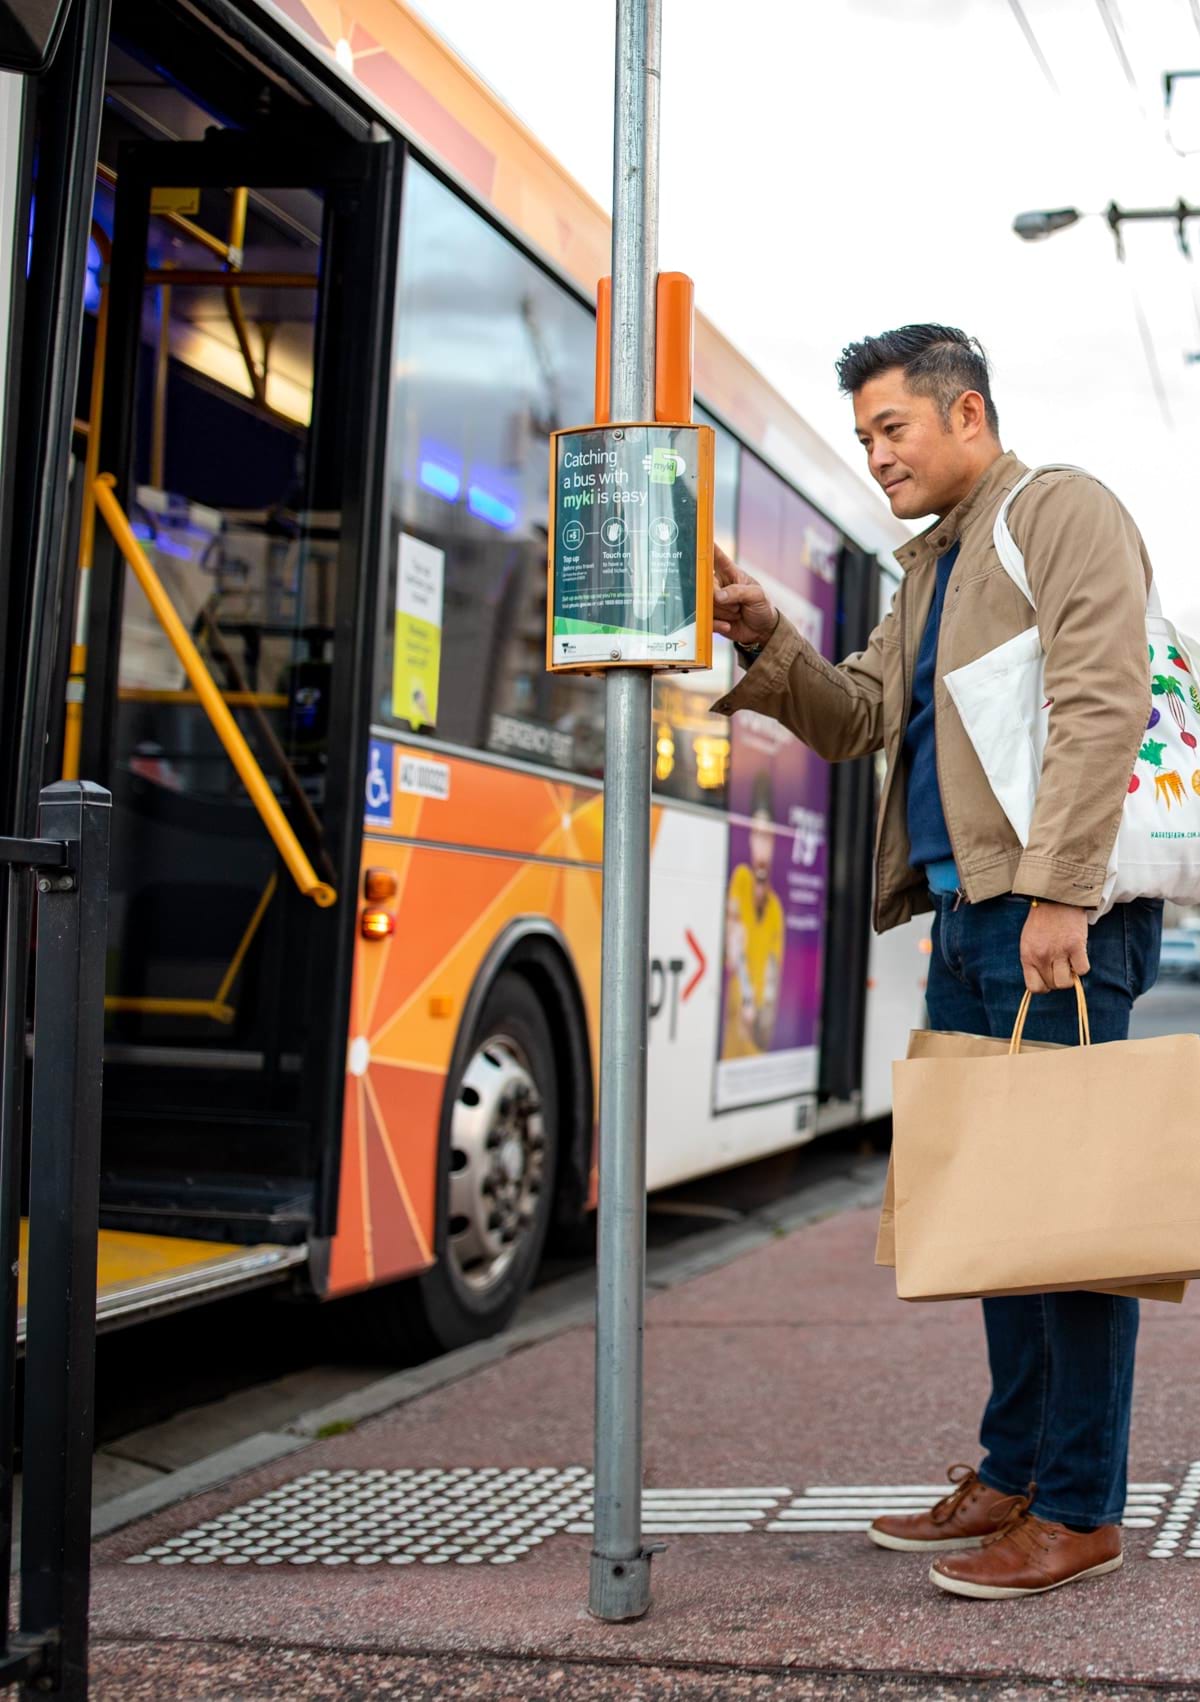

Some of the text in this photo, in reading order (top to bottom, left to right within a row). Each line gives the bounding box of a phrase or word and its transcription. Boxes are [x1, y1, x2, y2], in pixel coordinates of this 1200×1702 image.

[564, 448, 617, 468] Catching
[653, 462, 674, 472] myki
[563, 468, 629, 489] a bus with
[563, 489, 649, 510] myki is easy
[563, 555, 580, 564] Top up
[602, 551, 621, 559] Touch
[672, 551, 682, 559] off
[665, 642, 679, 652] PT
